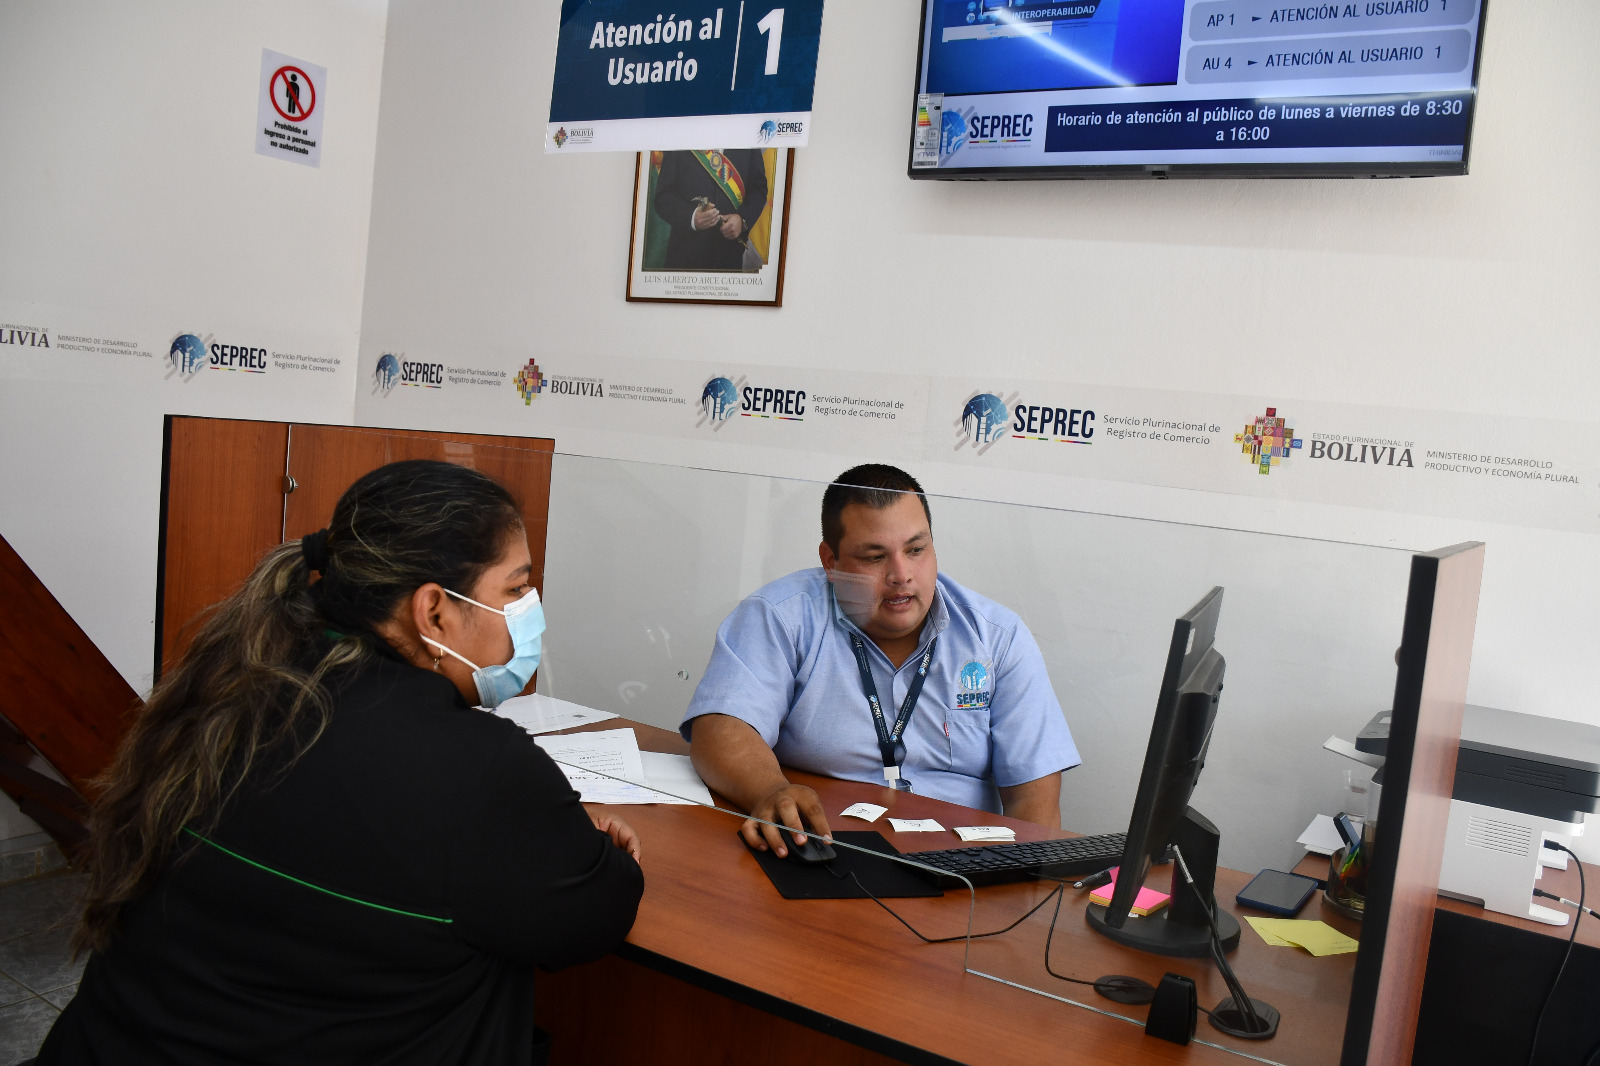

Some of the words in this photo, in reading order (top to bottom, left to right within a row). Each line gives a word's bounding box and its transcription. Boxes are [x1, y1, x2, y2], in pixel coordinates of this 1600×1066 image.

[1012, 5, 1096, 20] INTEROPERABILIDAD
[1207, 14, 1225, 27] AP
[1229, 14, 1235, 26] 1
[1270, 4, 1339, 23] ATENCIÓN
[1342, 4, 1360, 18] AL
[1365, 0, 1429, 17] USUARIO
[1441, 0, 1447, 11] 1
[589, 14, 693, 49] Atención
[699, 8, 723, 40] al
[756, 8, 785, 75] 1
[1203, 57, 1220, 71] AU
[1224, 57, 1232, 69] 4
[1265, 48, 1334, 68] ATENCIÓN
[1338, 51, 1356, 64] AL
[1360, 46, 1423, 63] USUARIO
[1435, 46, 1442, 58] 1
[607, 51, 698, 86] Usuario
[1057, 112, 1102, 126] Horario
[1106, 111, 1122, 124] de
[1126, 109, 1182, 124] atención
[1186, 108, 1199, 122] al
[1202, 107, 1254, 124] público
[1259, 106, 1276, 120] de
[1280, 105, 1320, 120] lunes
[1326, 108, 1334, 118] a
[1340, 103, 1396, 118] viernes
[1400, 101, 1420, 116] de
[1426, 100, 1462, 116] 8:30
[274, 121, 301, 134] Prohibido
[777, 121, 803, 134] SEPREC
[970, 114, 1033, 138] SEPREC
[292, 136, 316, 148] personal
[1216, 130, 1224, 142] a
[1230, 127, 1270, 141] 16:00
[279, 142, 308, 155] autorizado
[721, 278, 763, 286] CATACORA
[58, 334, 92, 344] MINISTERIO
[102, 339, 137, 348] DESARROLLO
[56, 344, 96, 352] PRODUCTIVO
[101, 346, 132, 356] ECONOMÍA
[210, 344, 267, 369] SEPREC
[272, 352, 296, 360] Servicio
[296, 354, 332, 364] Plurinacional
[274, 361, 300, 370] Registro
[308, 364, 336, 373] Comercio
[402, 362, 444, 384] SEPREC
[467, 368, 500, 378] Plurinacional
[448, 376, 470, 384] Registro
[551, 380, 604, 398] BOLIVIA
[742, 386, 806, 416] SEPREC
[812, 394, 841, 404] Servicio
[842, 396, 893, 409] Plurinacional
[894, 400, 904, 410] de
[814, 406, 846, 416] Registro
[848, 408, 858, 416] de
[860, 410, 896, 420] Comercio
[1013, 404, 1096, 438] SEPREC
[1103, 414, 1140, 426] Servicio
[1142, 417, 1206, 432] Plurinacional
[1208, 422, 1221, 432] de
[1106, 428, 1146, 440] Registro
[1149, 430, 1161, 440] de
[1163, 432, 1210, 444] Comercio
[1312, 432, 1341, 440] ESTADO
[1342, 436, 1402, 446] PLURINACIONAL
[1310, 440, 1414, 468] BOLIVIA
[1426, 450, 1478, 462] MINISTERIO
[1480, 456, 1492, 464] DE
[1494, 457, 1552, 469] DESARROLLO
[1424, 462, 1482, 474] PRODUCTIVO
[1492, 468, 1542, 480] ECONOMÍA
[1544, 473, 1580, 484] PLURAL
[956, 692, 990, 704] SEPREC
